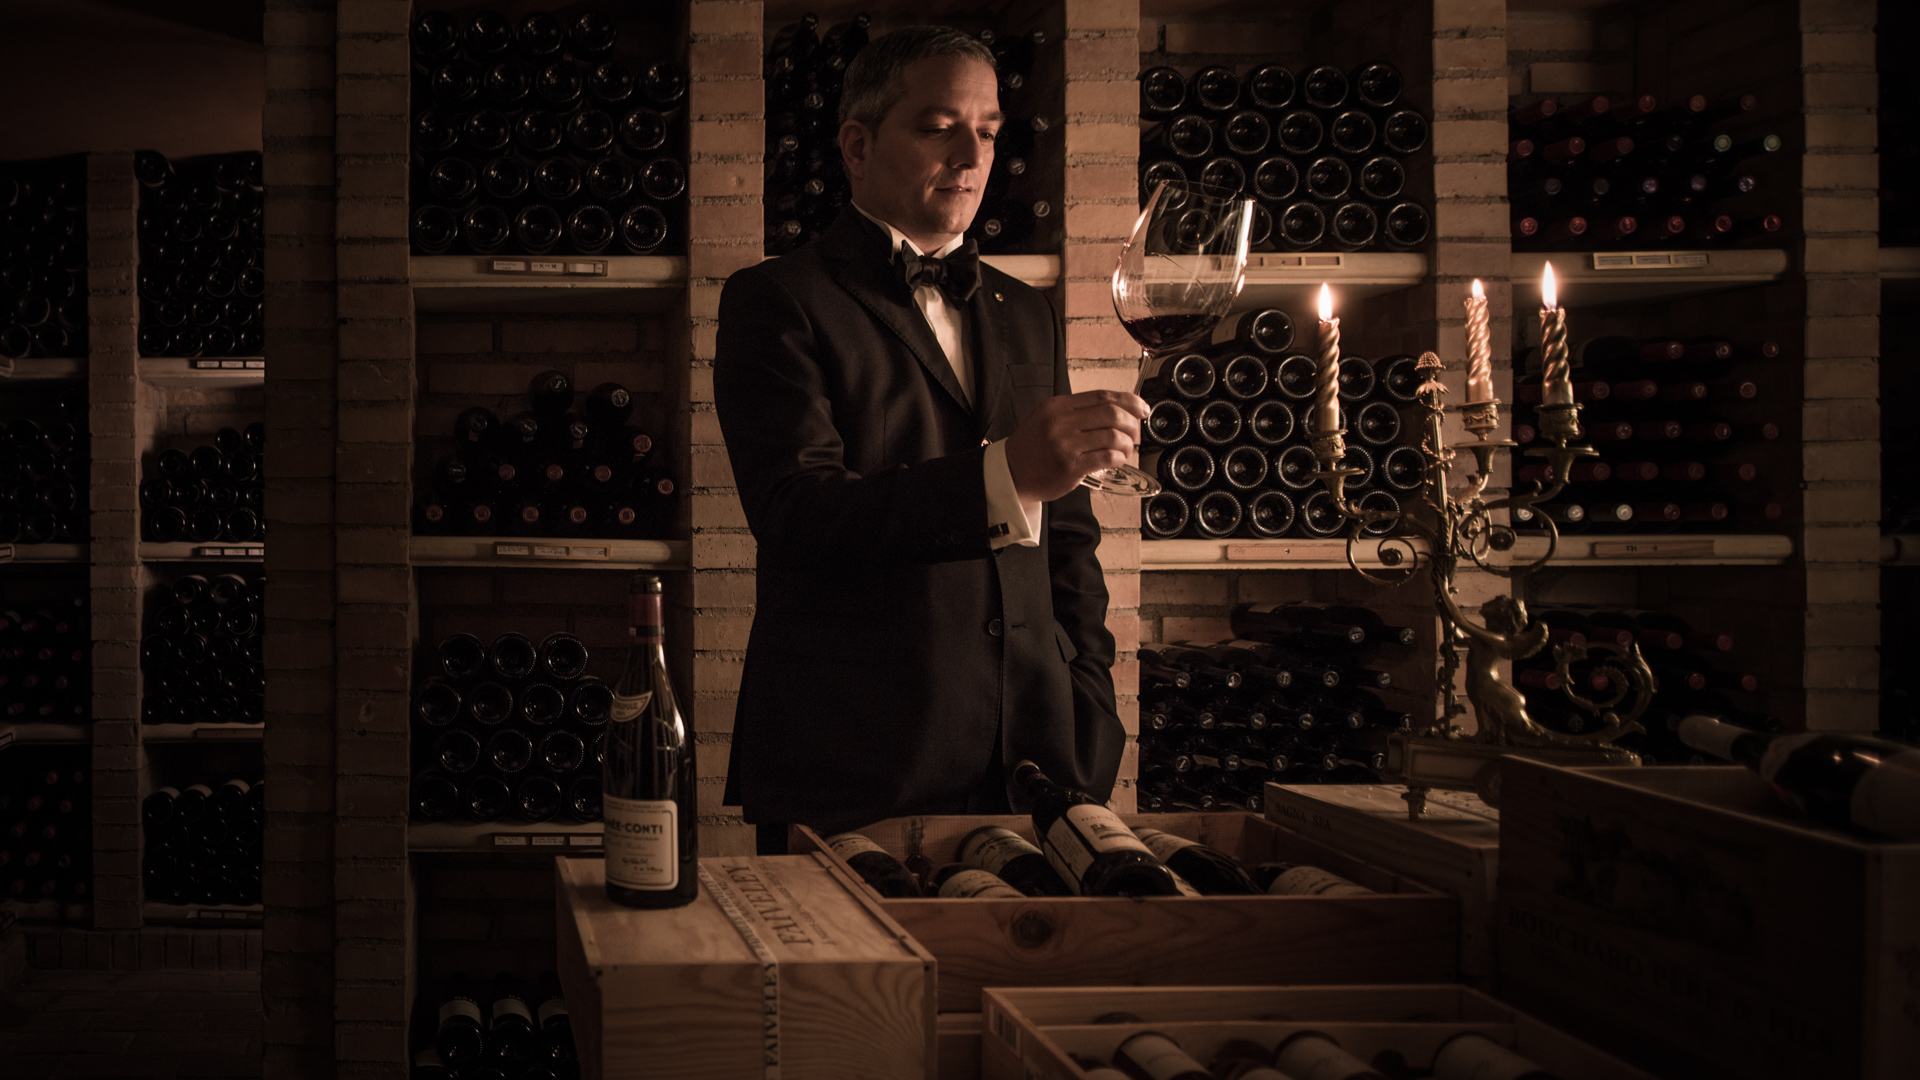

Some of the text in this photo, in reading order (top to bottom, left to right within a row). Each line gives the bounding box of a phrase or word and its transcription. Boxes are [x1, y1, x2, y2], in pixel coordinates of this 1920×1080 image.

[1275, 801, 1306, 823] SAGNA
[1312, 814, 1331, 832] SPA
[722, 864, 815, 946] FAIVELEY
[1507, 905, 1644, 979] BOUCHARD
[764, 962, 779, 1067] FAIVELEY
